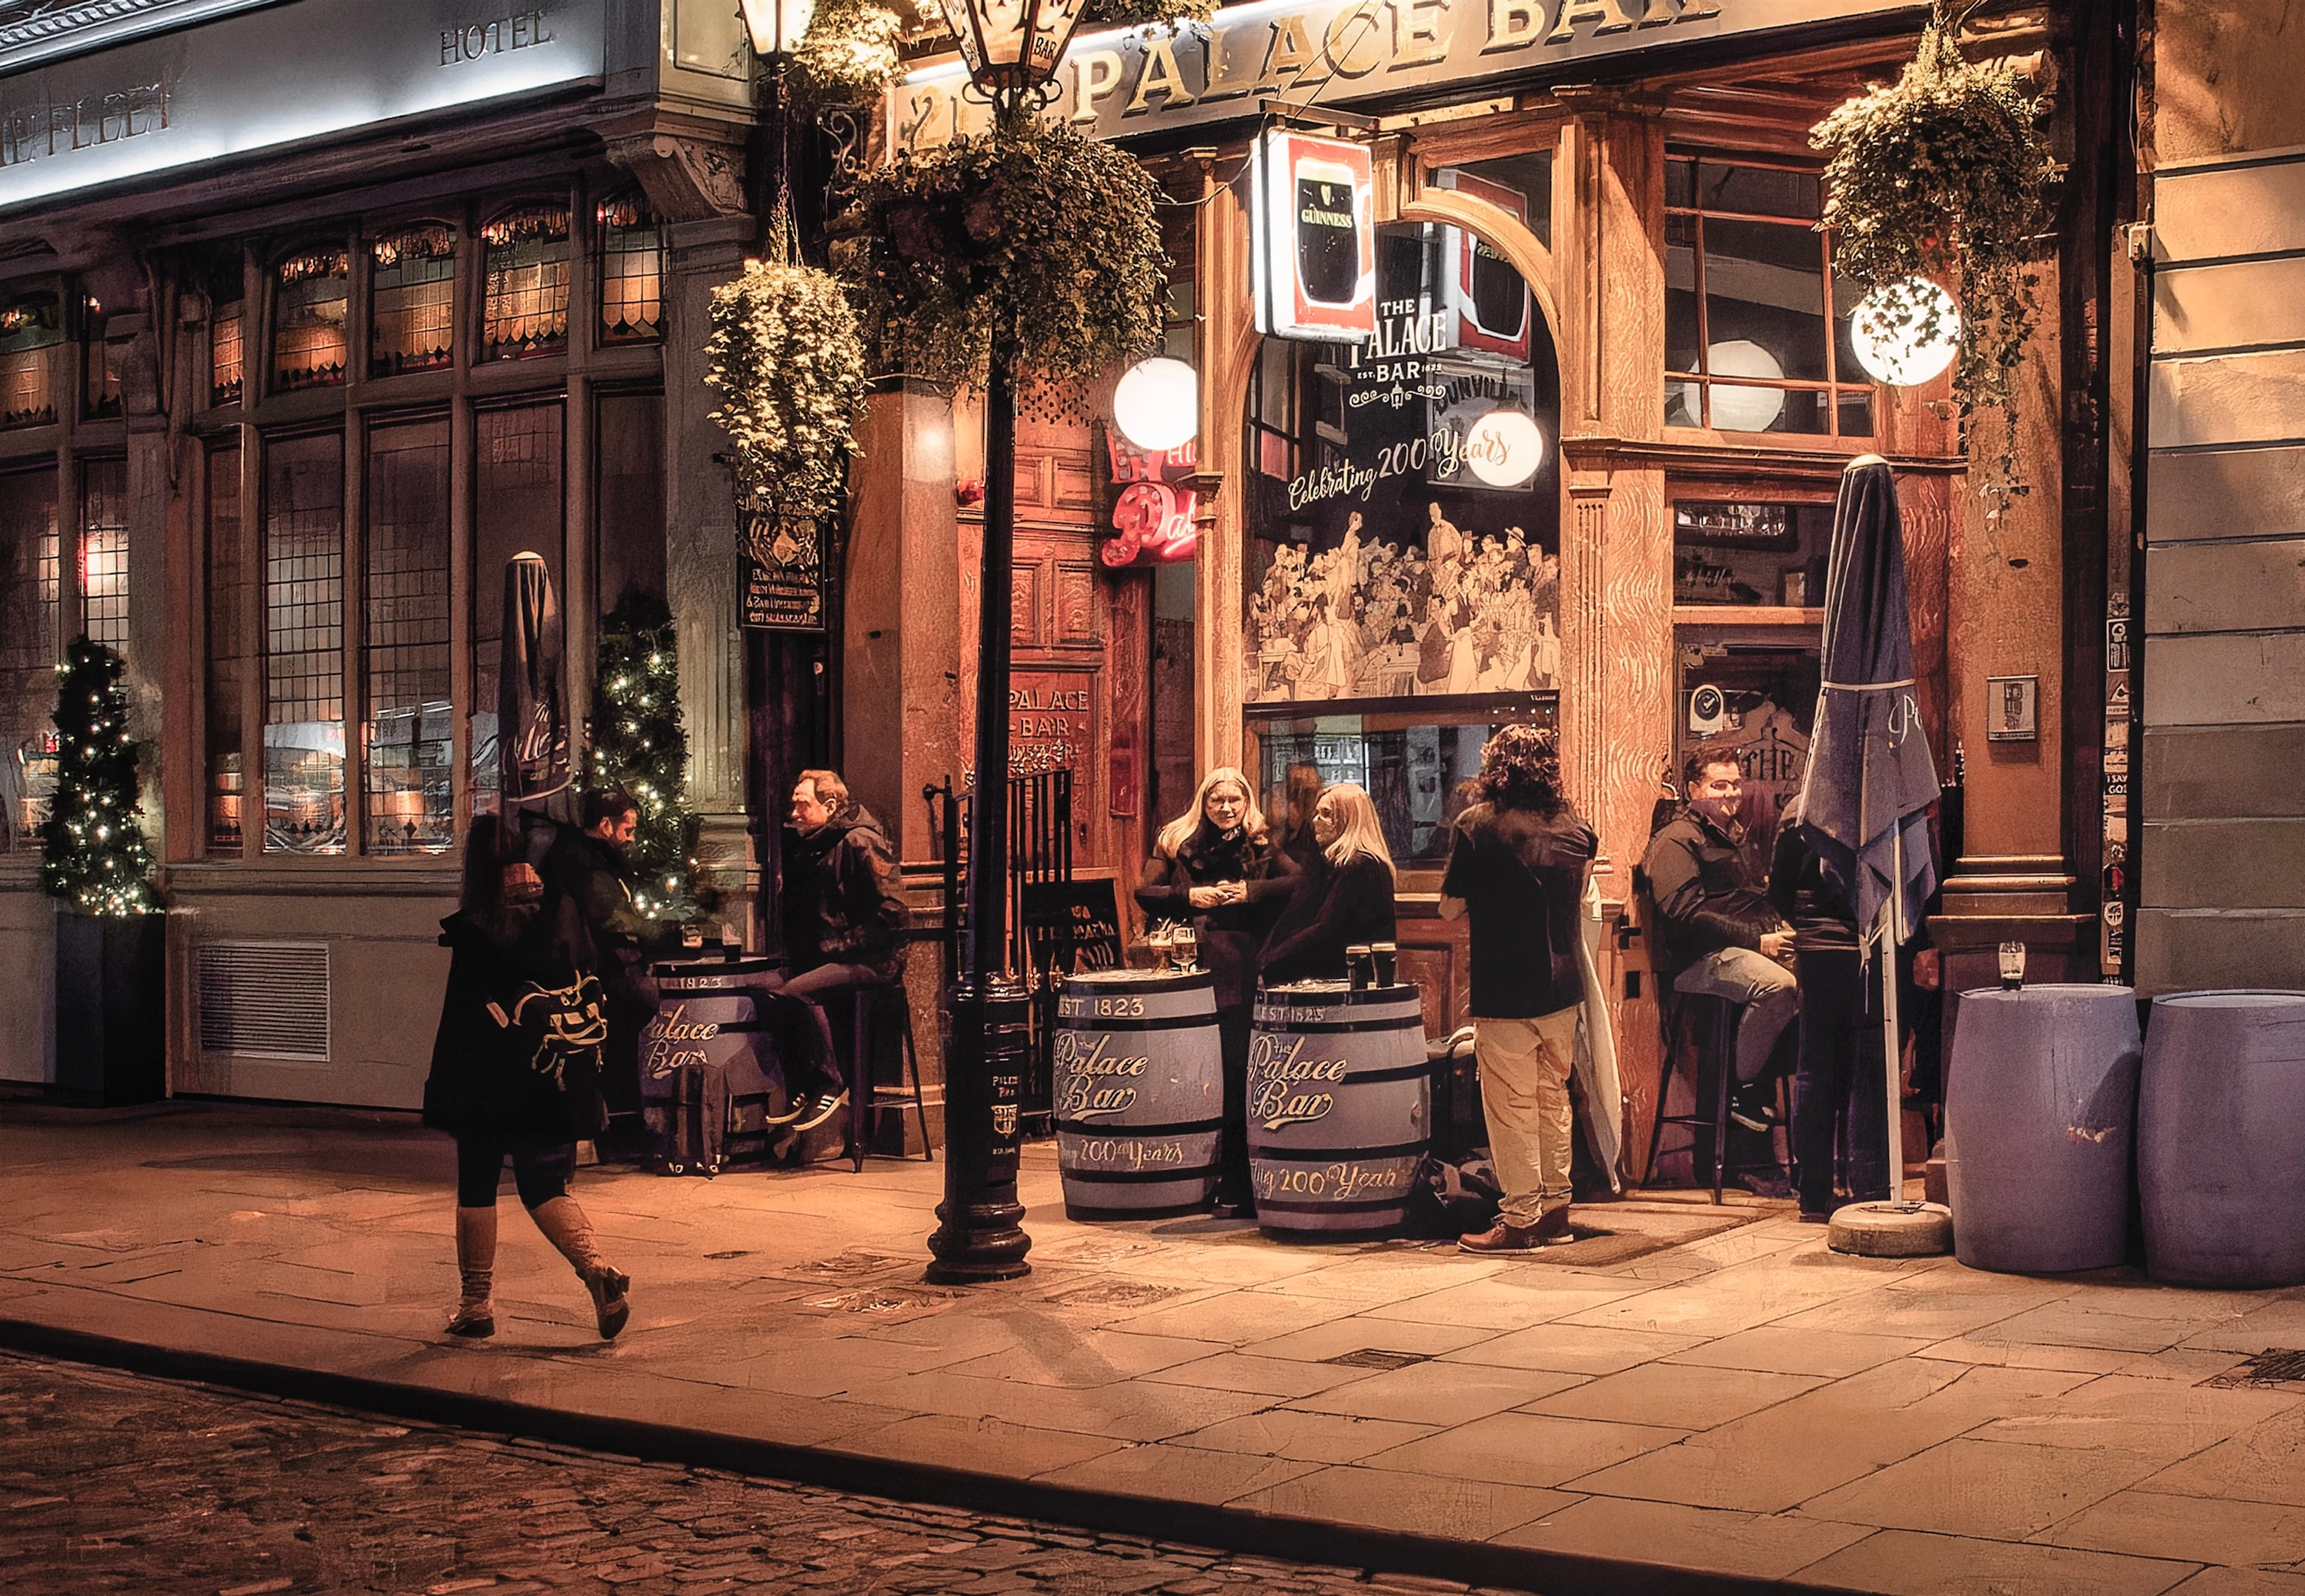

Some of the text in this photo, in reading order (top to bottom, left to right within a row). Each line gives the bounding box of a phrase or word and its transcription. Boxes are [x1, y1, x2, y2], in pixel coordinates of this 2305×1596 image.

[439, 11, 554, 67] HOTEL
[1070, 0, 1453, 125] PALACE
[1301, 209, 1353, 229] GUINNESS
[1381, 299, 1415, 317] THE
[1376, 361, 1420, 382] BAR
[1288, 427, 1511, 511] Celebrating 200 Years
[1020, 717, 1070, 737] BAR
[1094, 997, 1144, 1016] 1823
[1055, 1033, 1148, 1076] Palace
[1249, 1034, 1347, 1082] Palace
[1061, 1074, 1136, 1119] Bar
[1250, 1080, 1333, 1128] Bar
[1081, 1139, 1116, 1161] 200
[1279, 1168, 1324, 1194] 200
